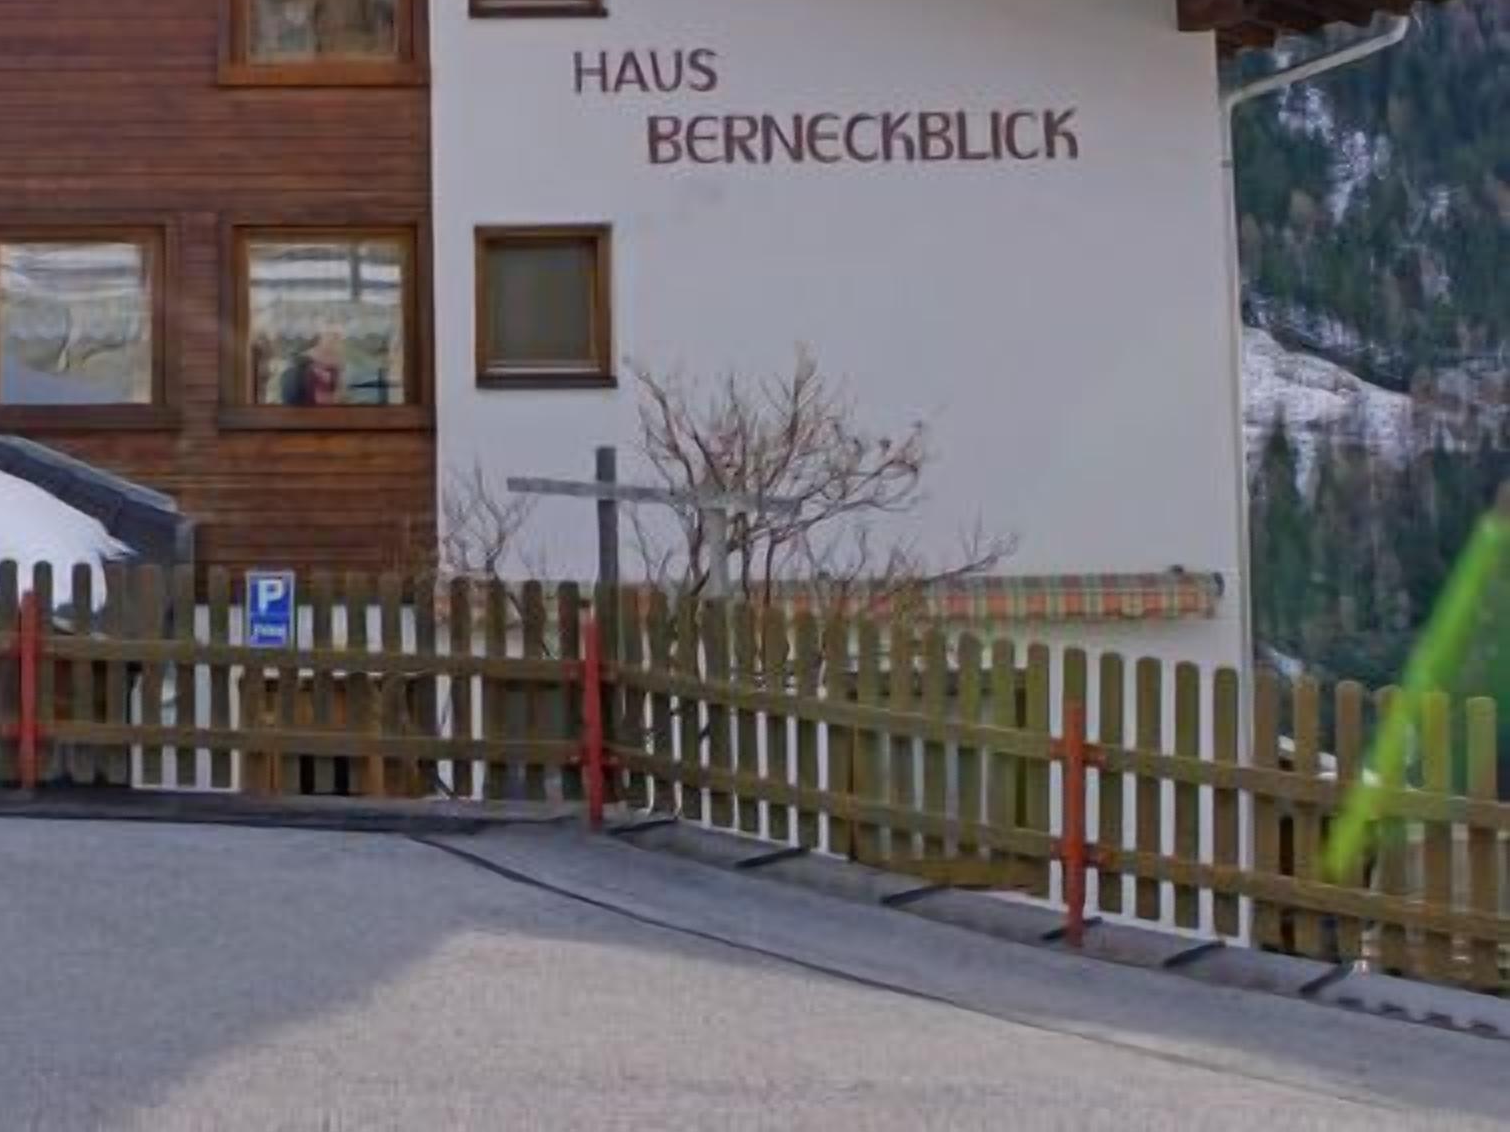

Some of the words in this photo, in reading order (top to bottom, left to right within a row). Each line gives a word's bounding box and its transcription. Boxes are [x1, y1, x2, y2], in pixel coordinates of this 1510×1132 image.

[572, 48, 719, 94] HAUS
[646, 108, 1079, 165] BERNECKBLICK
[258, 579, 284, 616] P
